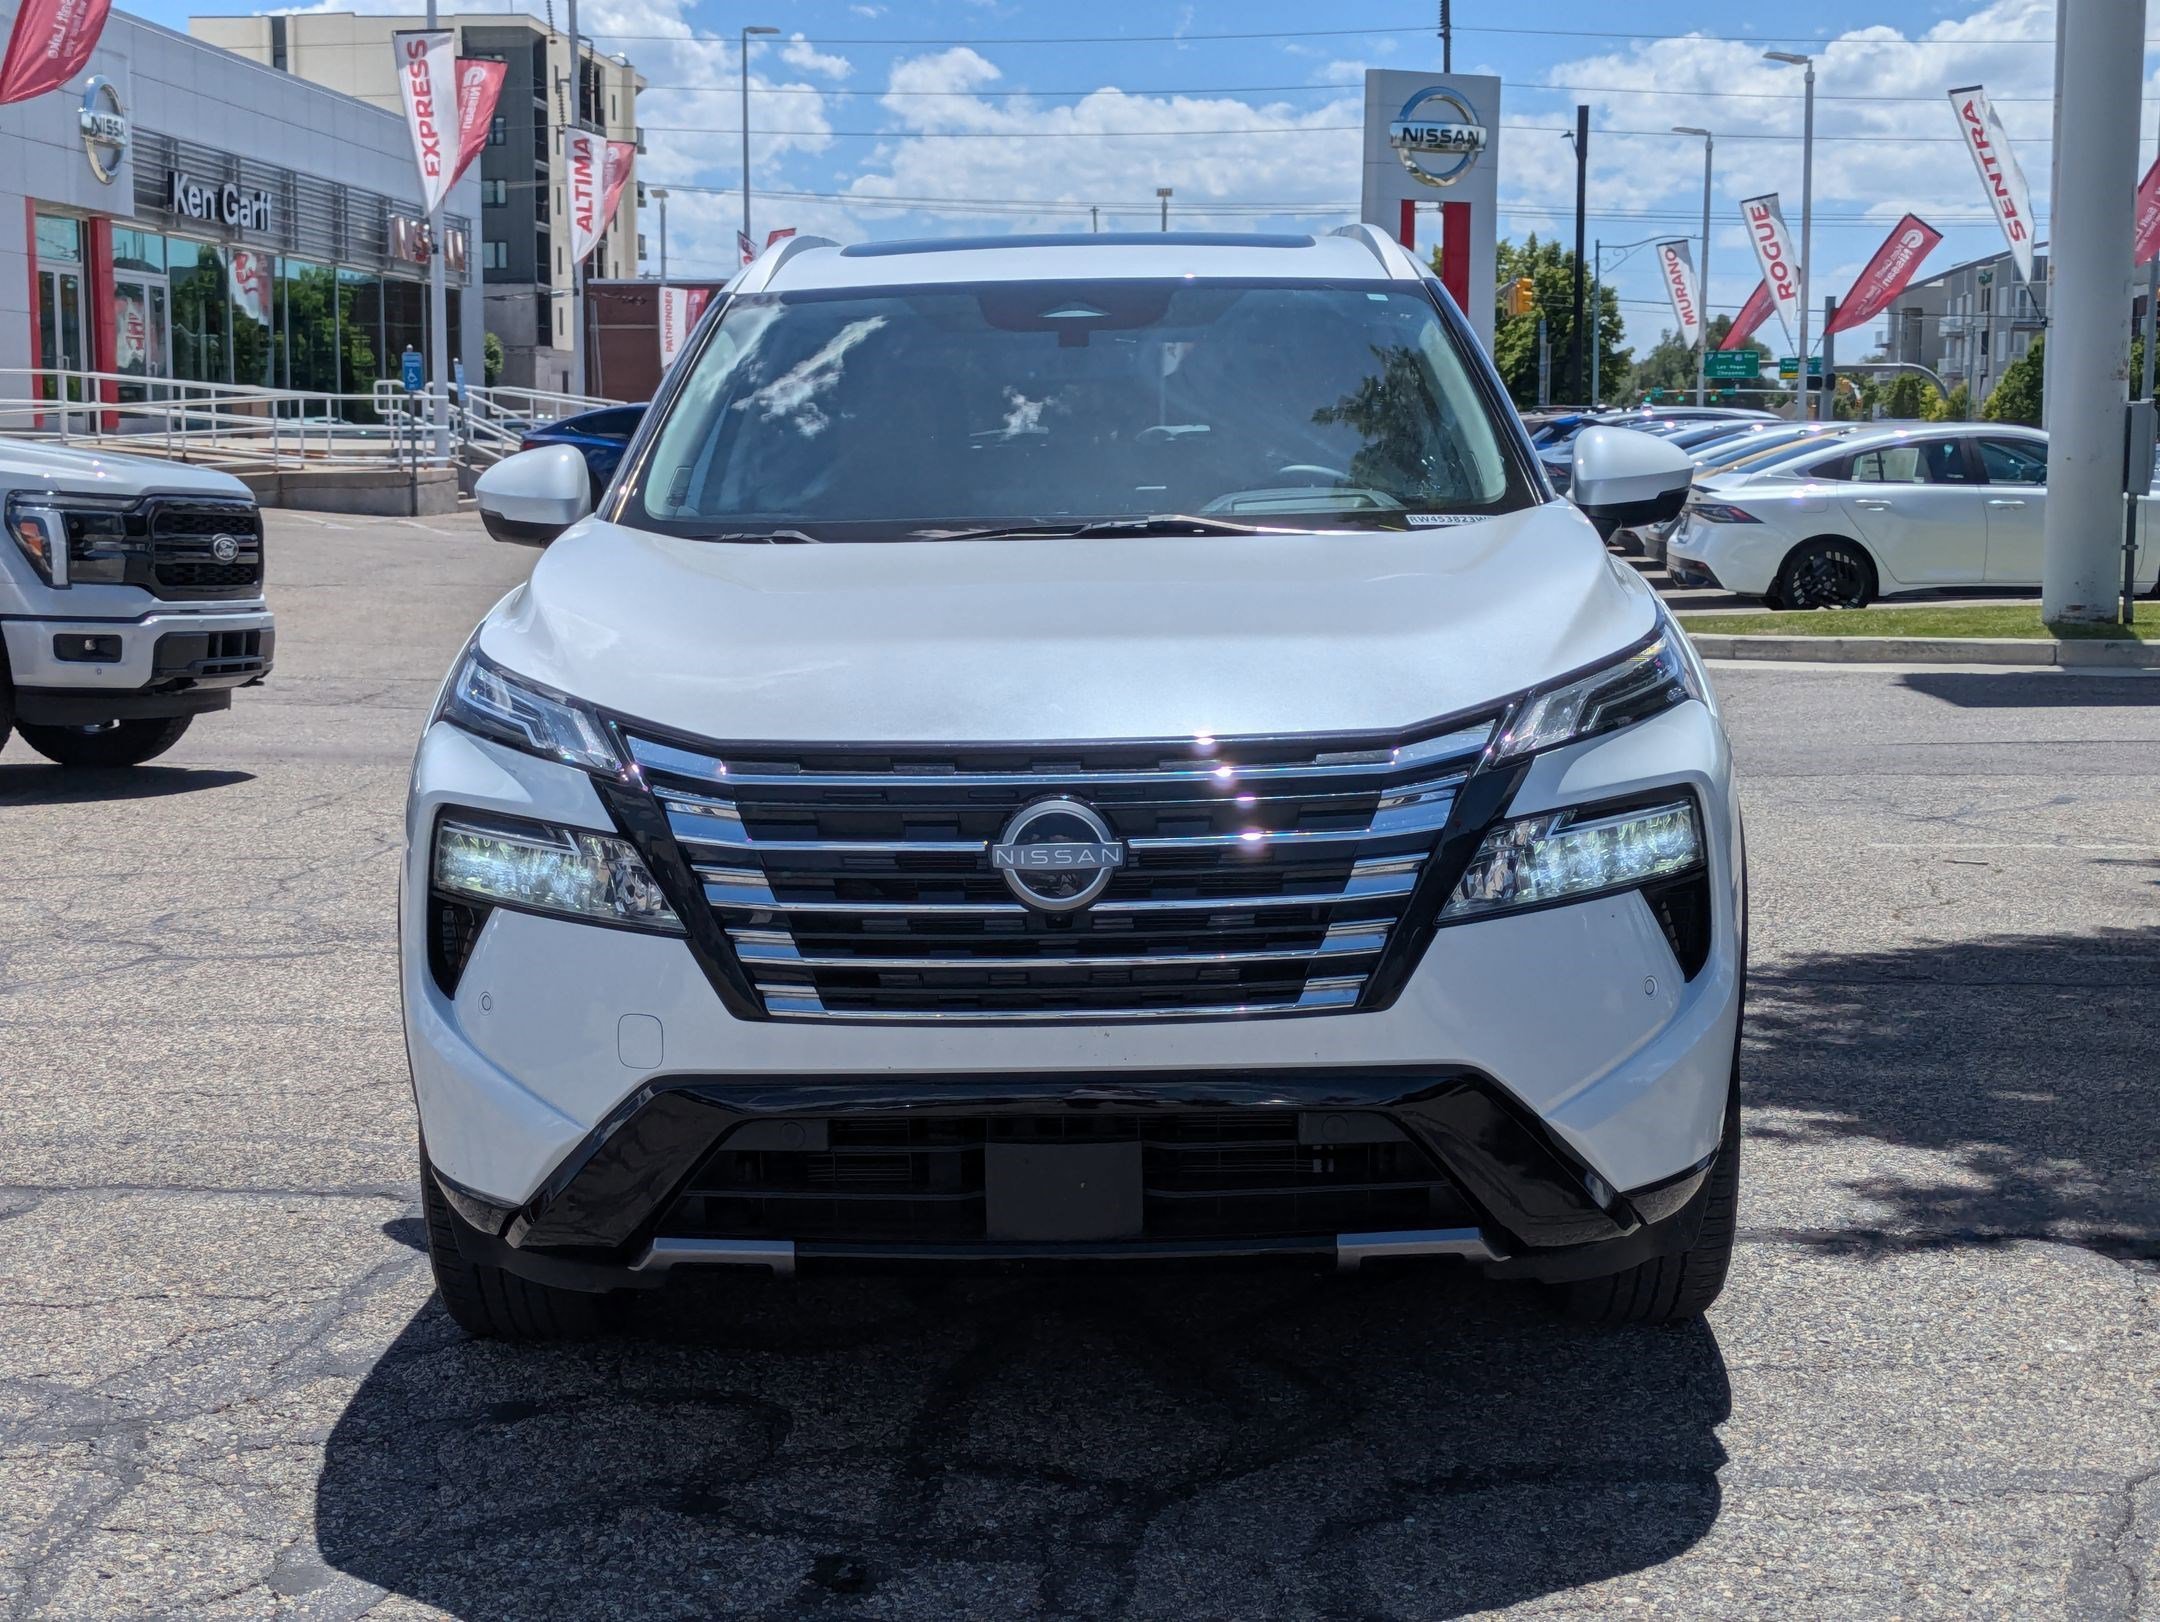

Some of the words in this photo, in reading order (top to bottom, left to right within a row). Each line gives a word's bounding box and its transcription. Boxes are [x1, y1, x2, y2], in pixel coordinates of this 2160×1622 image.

[91, 115, 125, 138] NISSA
[407, 39, 441, 177] EXPRESS
[1402, 127, 1479, 145] NISSAN
[171, 171, 216, 220] Ken
[219, 183, 273, 232] Garff
[573, 138, 592, 234] ALTIMA
[1962, 100, 2027, 242] SENTRA
[1665, 248, 1698, 326] MURANO
[1750, 203, 1796, 301] ROGUE
[665, 290, 675, 353] PATHFINDER
[996, 848, 1120, 865] NISSAN
